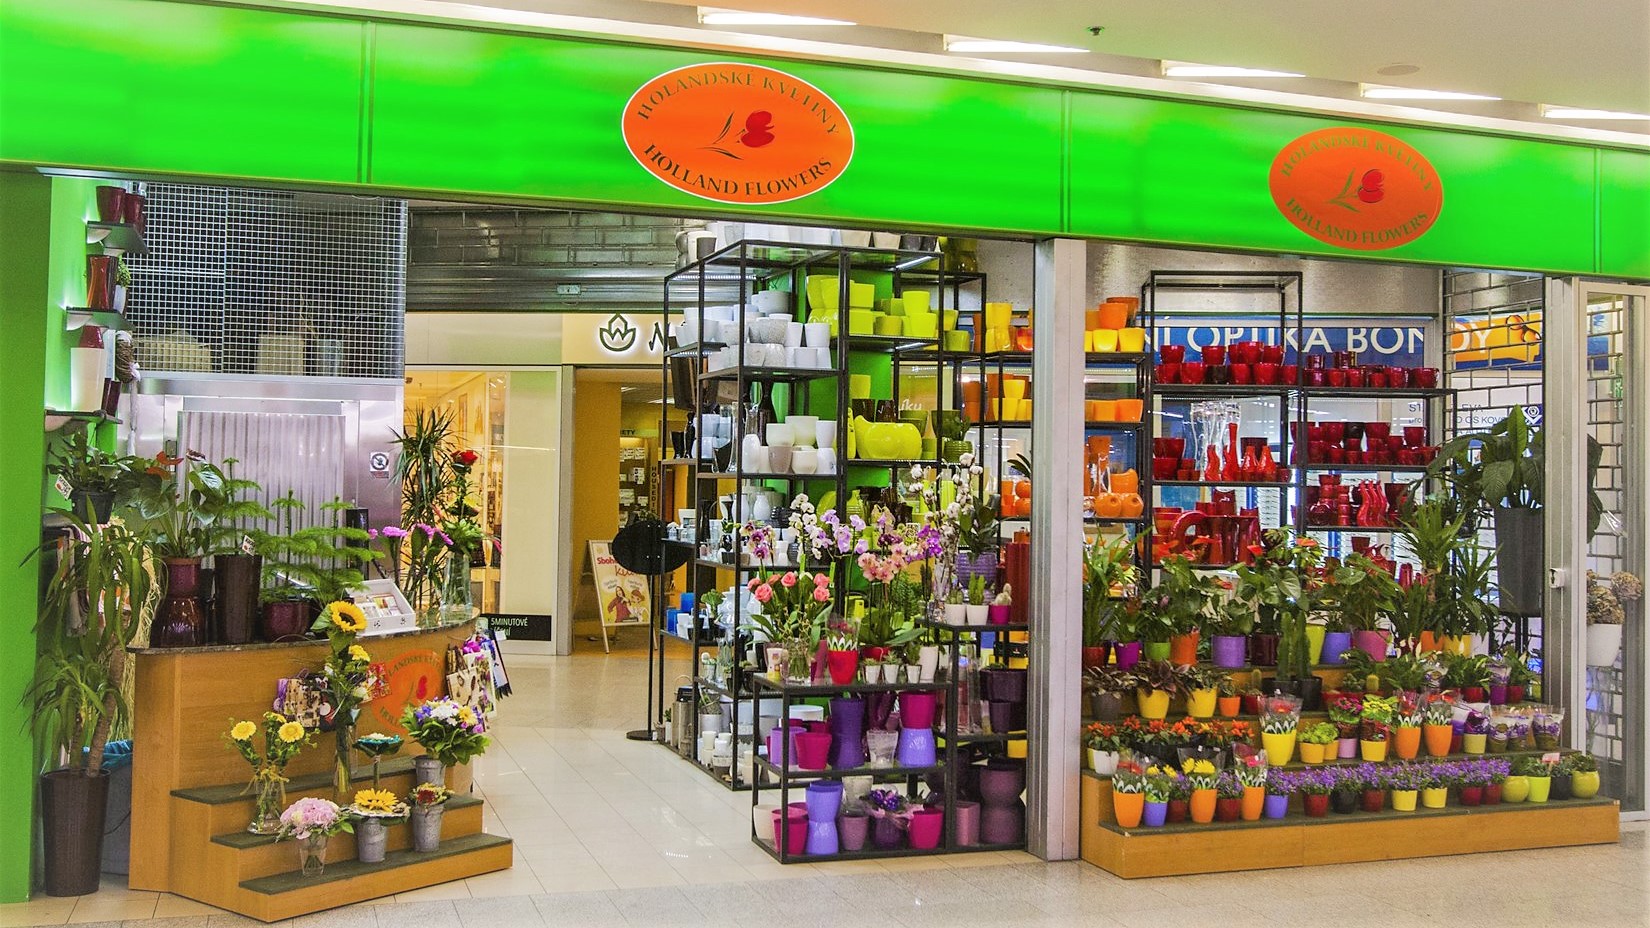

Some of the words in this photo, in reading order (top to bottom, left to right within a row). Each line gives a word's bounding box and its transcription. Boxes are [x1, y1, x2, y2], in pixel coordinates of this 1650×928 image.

[643, 143, 739, 195] HOLLAND
[745, 156, 832, 196] FLOWERS
[1285, 197, 1358, 244] HOLLAND
[1361, 211, 1428, 244] FLOWERS
